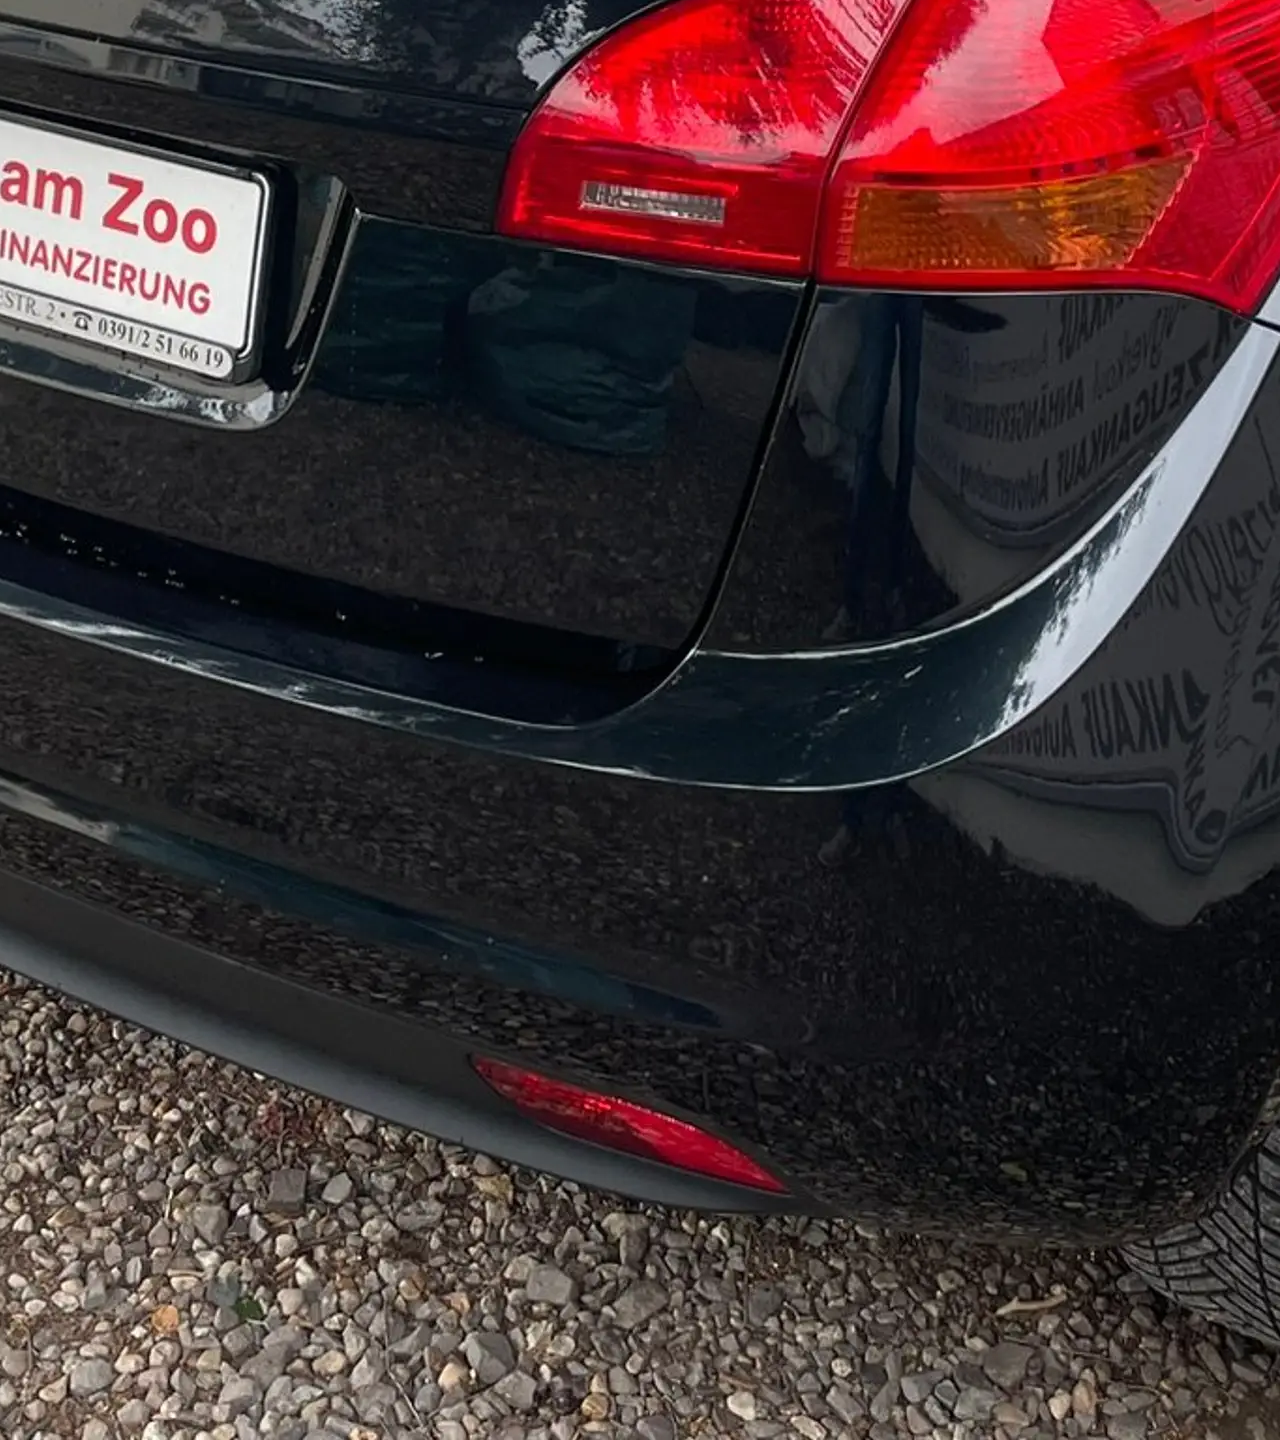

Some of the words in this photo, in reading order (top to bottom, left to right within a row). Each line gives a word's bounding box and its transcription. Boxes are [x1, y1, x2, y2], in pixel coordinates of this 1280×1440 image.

[0, 159, 83, 220] am
[101, 172, 218, 254] Zoo
[44, 301, 57, 321] 2
[97, 317, 150, 349] 0391/2
[155, 333, 174, 356] 51
[178, 340, 199, 362] 66
[205, 345, 224, 370] 19
